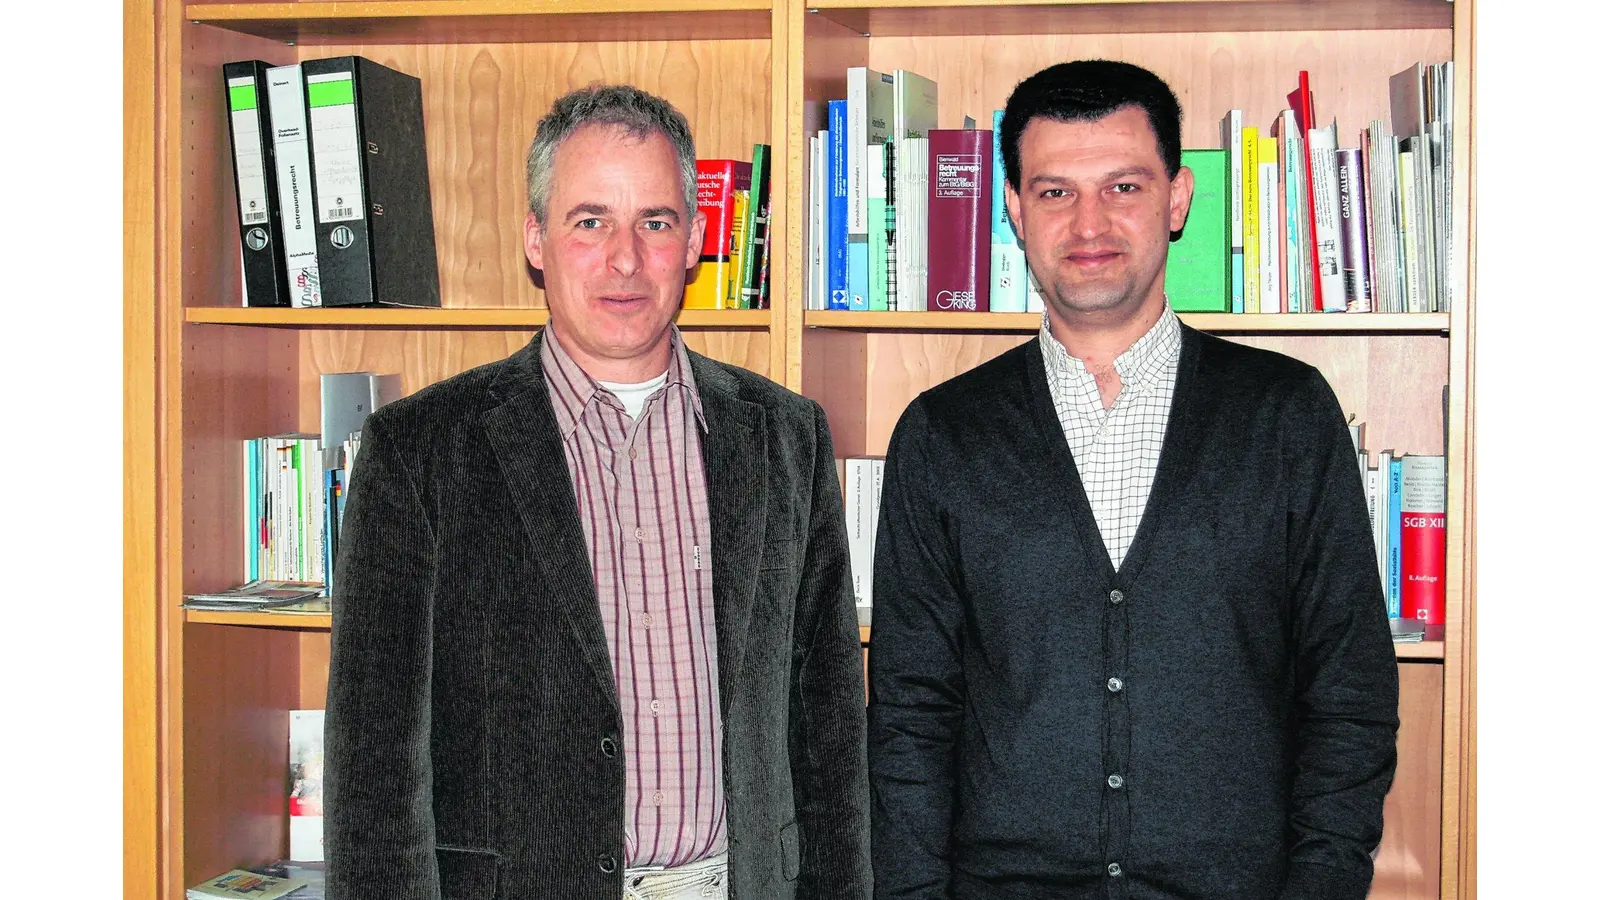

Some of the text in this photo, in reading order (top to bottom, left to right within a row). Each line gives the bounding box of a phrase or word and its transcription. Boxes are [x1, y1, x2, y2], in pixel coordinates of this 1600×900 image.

[697, 180, 720, 189] utsche
[697, 189, 716, 198] echt-
[944, 189, 964, 197] Auflage
[1340, 166, 1350, 218] GANZ ALLEIN
[290, 165, 301, 230] Betreuungsrecht
[697, 197, 725, 209] reibung
[1404, 517, 1444, 528] SGB XII
[1415, 574, 1438, 583] Auflage
